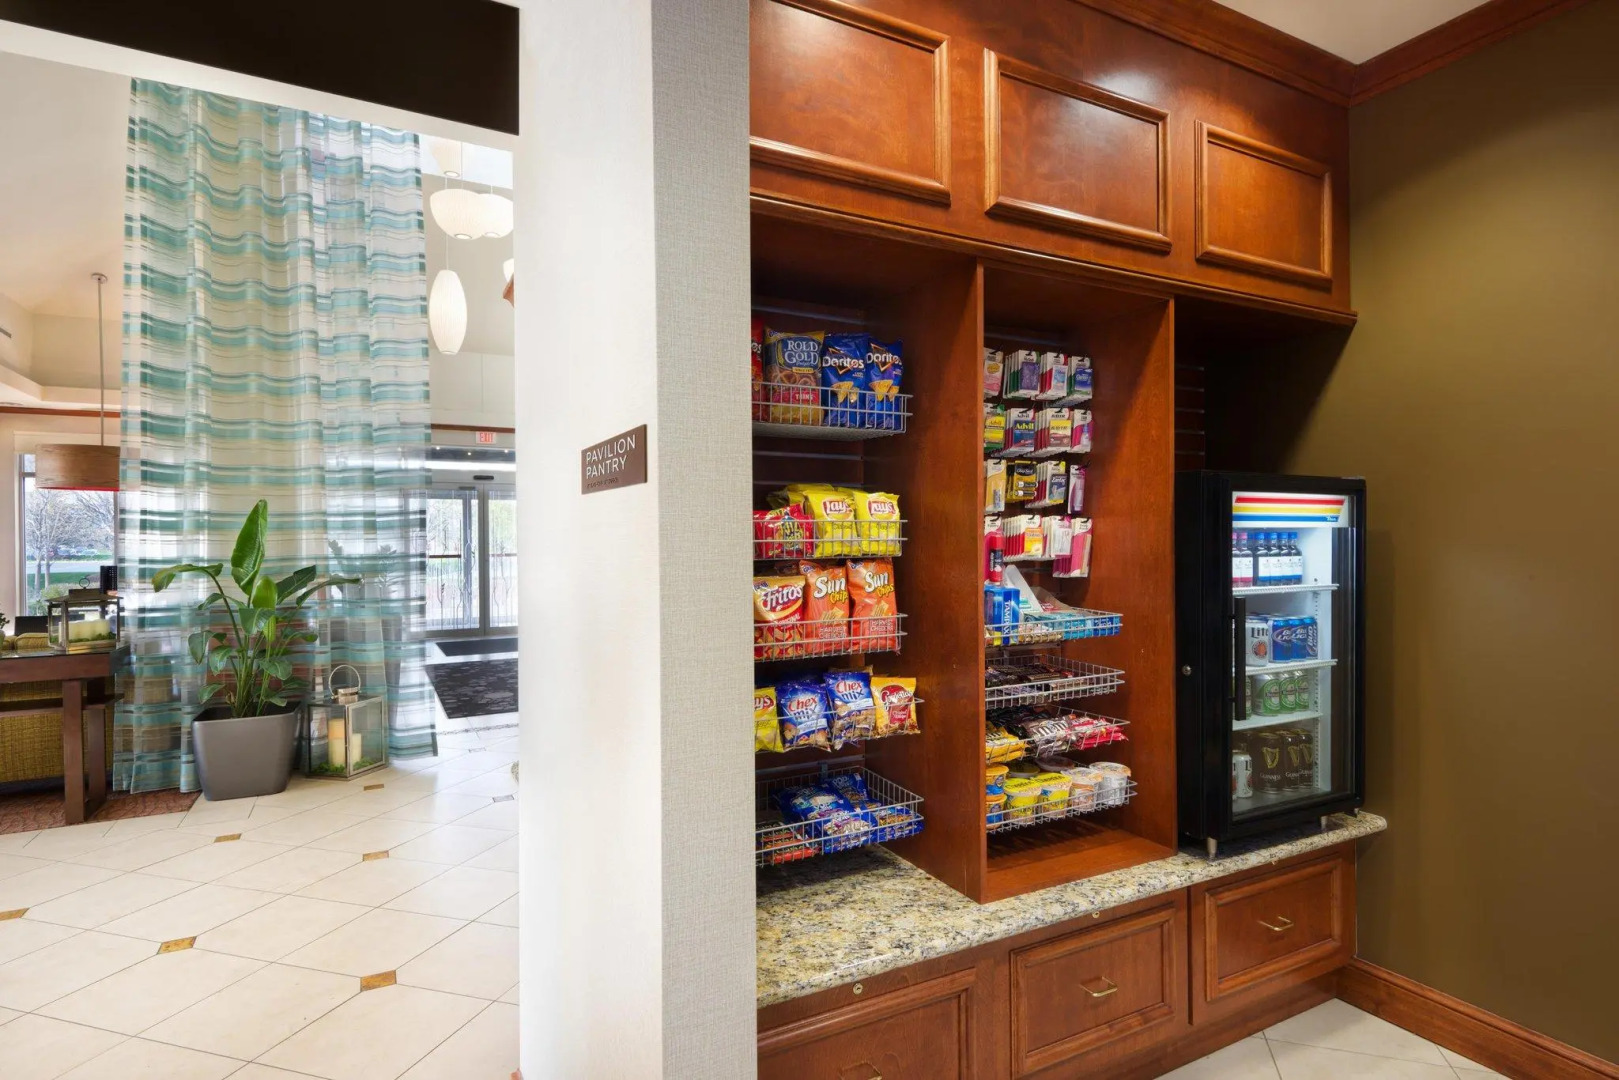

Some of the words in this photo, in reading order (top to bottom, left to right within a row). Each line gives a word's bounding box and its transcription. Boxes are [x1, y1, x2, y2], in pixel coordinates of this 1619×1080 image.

[787, 340, 818, 352] ROLD
[784, 351, 819, 365] GOLD
[822, 356, 865, 369] Doritos
[866, 352, 903, 366] Doritos
[1015, 422, 1035, 430] Advil
[479, 432, 494, 443] EXIT
[586, 434, 636, 465] PAVILION
[586, 454, 627, 479] PANTRY
[813, 576, 846, 598] Sun
[864, 571, 890, 593] Sun
[762, 585, 803, 611] Fritos
[874, 585, 894, 599] Chips
[1004, 600, 1012, 635] TAMPAX
[834, 681, 861, 694] Chex
[841, 689, 864, 700] mix
[788, 696, 817, 711] Chex
